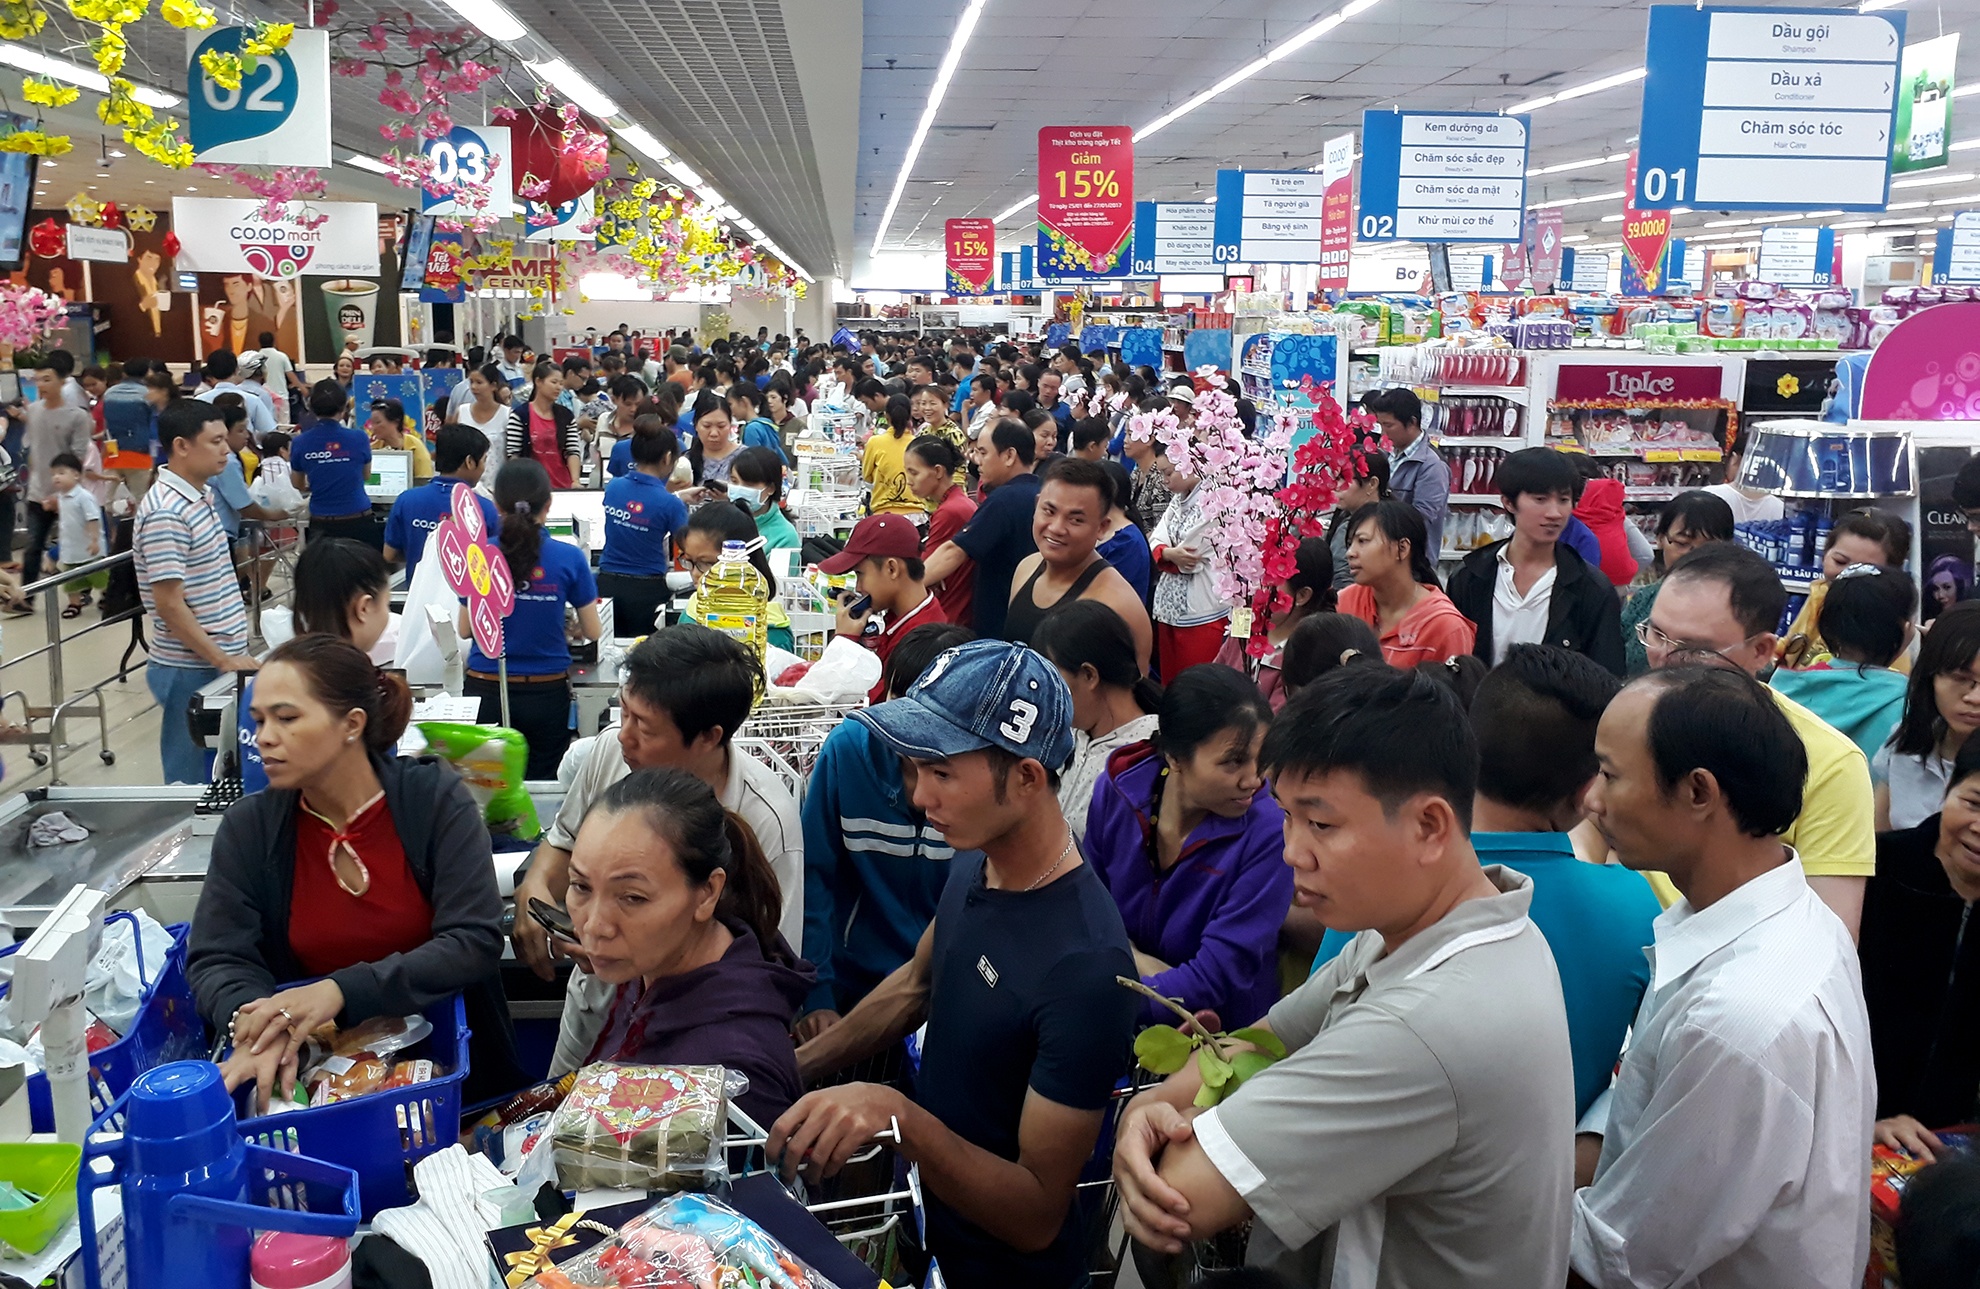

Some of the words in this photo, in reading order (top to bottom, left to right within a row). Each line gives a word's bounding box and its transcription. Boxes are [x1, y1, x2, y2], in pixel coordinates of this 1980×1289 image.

[1772, 22, 1802, 37] Dầu
[1806, 25, 1830, 42] gội
[203, 54, 285, 112] 02
[1771, 70, 1800, 86] Dầu
[1804, 72, 1822, 86] xả
[1774, 92, 1815, 101] Conditioner
[1425, 122, 1447, 132] Kem
[1449, 122, 1484, 135] dưỡng
[1486, 123, 1499, 133] da
[1741, 120, 1784, 134] Chăm
[1788, 121, 1815, 135] sóc
[1820, 122, 1843, 135] tóc
[1069, 131, 1082, 139] Dịch
[1094, 139, 1109, 147] ngày
[1110, 138, 1121, 146] Tết
[1789, 141, 1807, 149] Care
[429, 142, 487, 183] 03
[1071, 151, 1101, 165] Giảm
[1414, 153, 1443, 163] Chăm
[1446, 153, 1464, 163] sóc
[1466, 152, 1484, 163] sắc
[1486, 154, 1505, 166] đẹp
[1055, 169, 1119, 198] 15%
[1415, 184, 1444, 194] Chăm
[1447, 185, 1464, 194] sóc
[1467, 184, 1480, 194] da
[1482, 185, 1500, 196] mặt
[1644, 167, 1687, 202] 01
[1273, 199, 1296, 209] người
[1299, 200, 1310, 210] già
[1418, 214, 1440, 225] Khử
[1442, 215, 1461, 225] mùi
[1462, 216, 1475, 226] cơ
[1282, 223, 1292, 232] vệ
[1293, 223, 1309, 231] sinh
[1362, 215, 1393, 239] 02
[1627, 218, 1666, 239] 59.000đ
[287, 231, 321, 242] mart
[954, 241, 988, 256] 15%
[1215, 245, 1239, 262] 03
[432, 251, 450, 263] Tết
[1165, 259, 1178, 267] May
[428, 262, 452, 275] Việt
[1135, 259, 1153, 273] 04
[1020, 280, 1032, 289] 07
[1560, 280, 1572, 289] 07
[1814, 272, 1829, 284] 05
[1933, 273, 1947, 284] 13
[1606, 369, 1675, 400] LipIce
[304, 451, 332, 460] co.op
[604, 505, 631, 521] co.op
[412, 519, 438, 530] co.o
[1794, 568, 1811, 578] SÂU
[1000, 698, 1039, 744] 3
